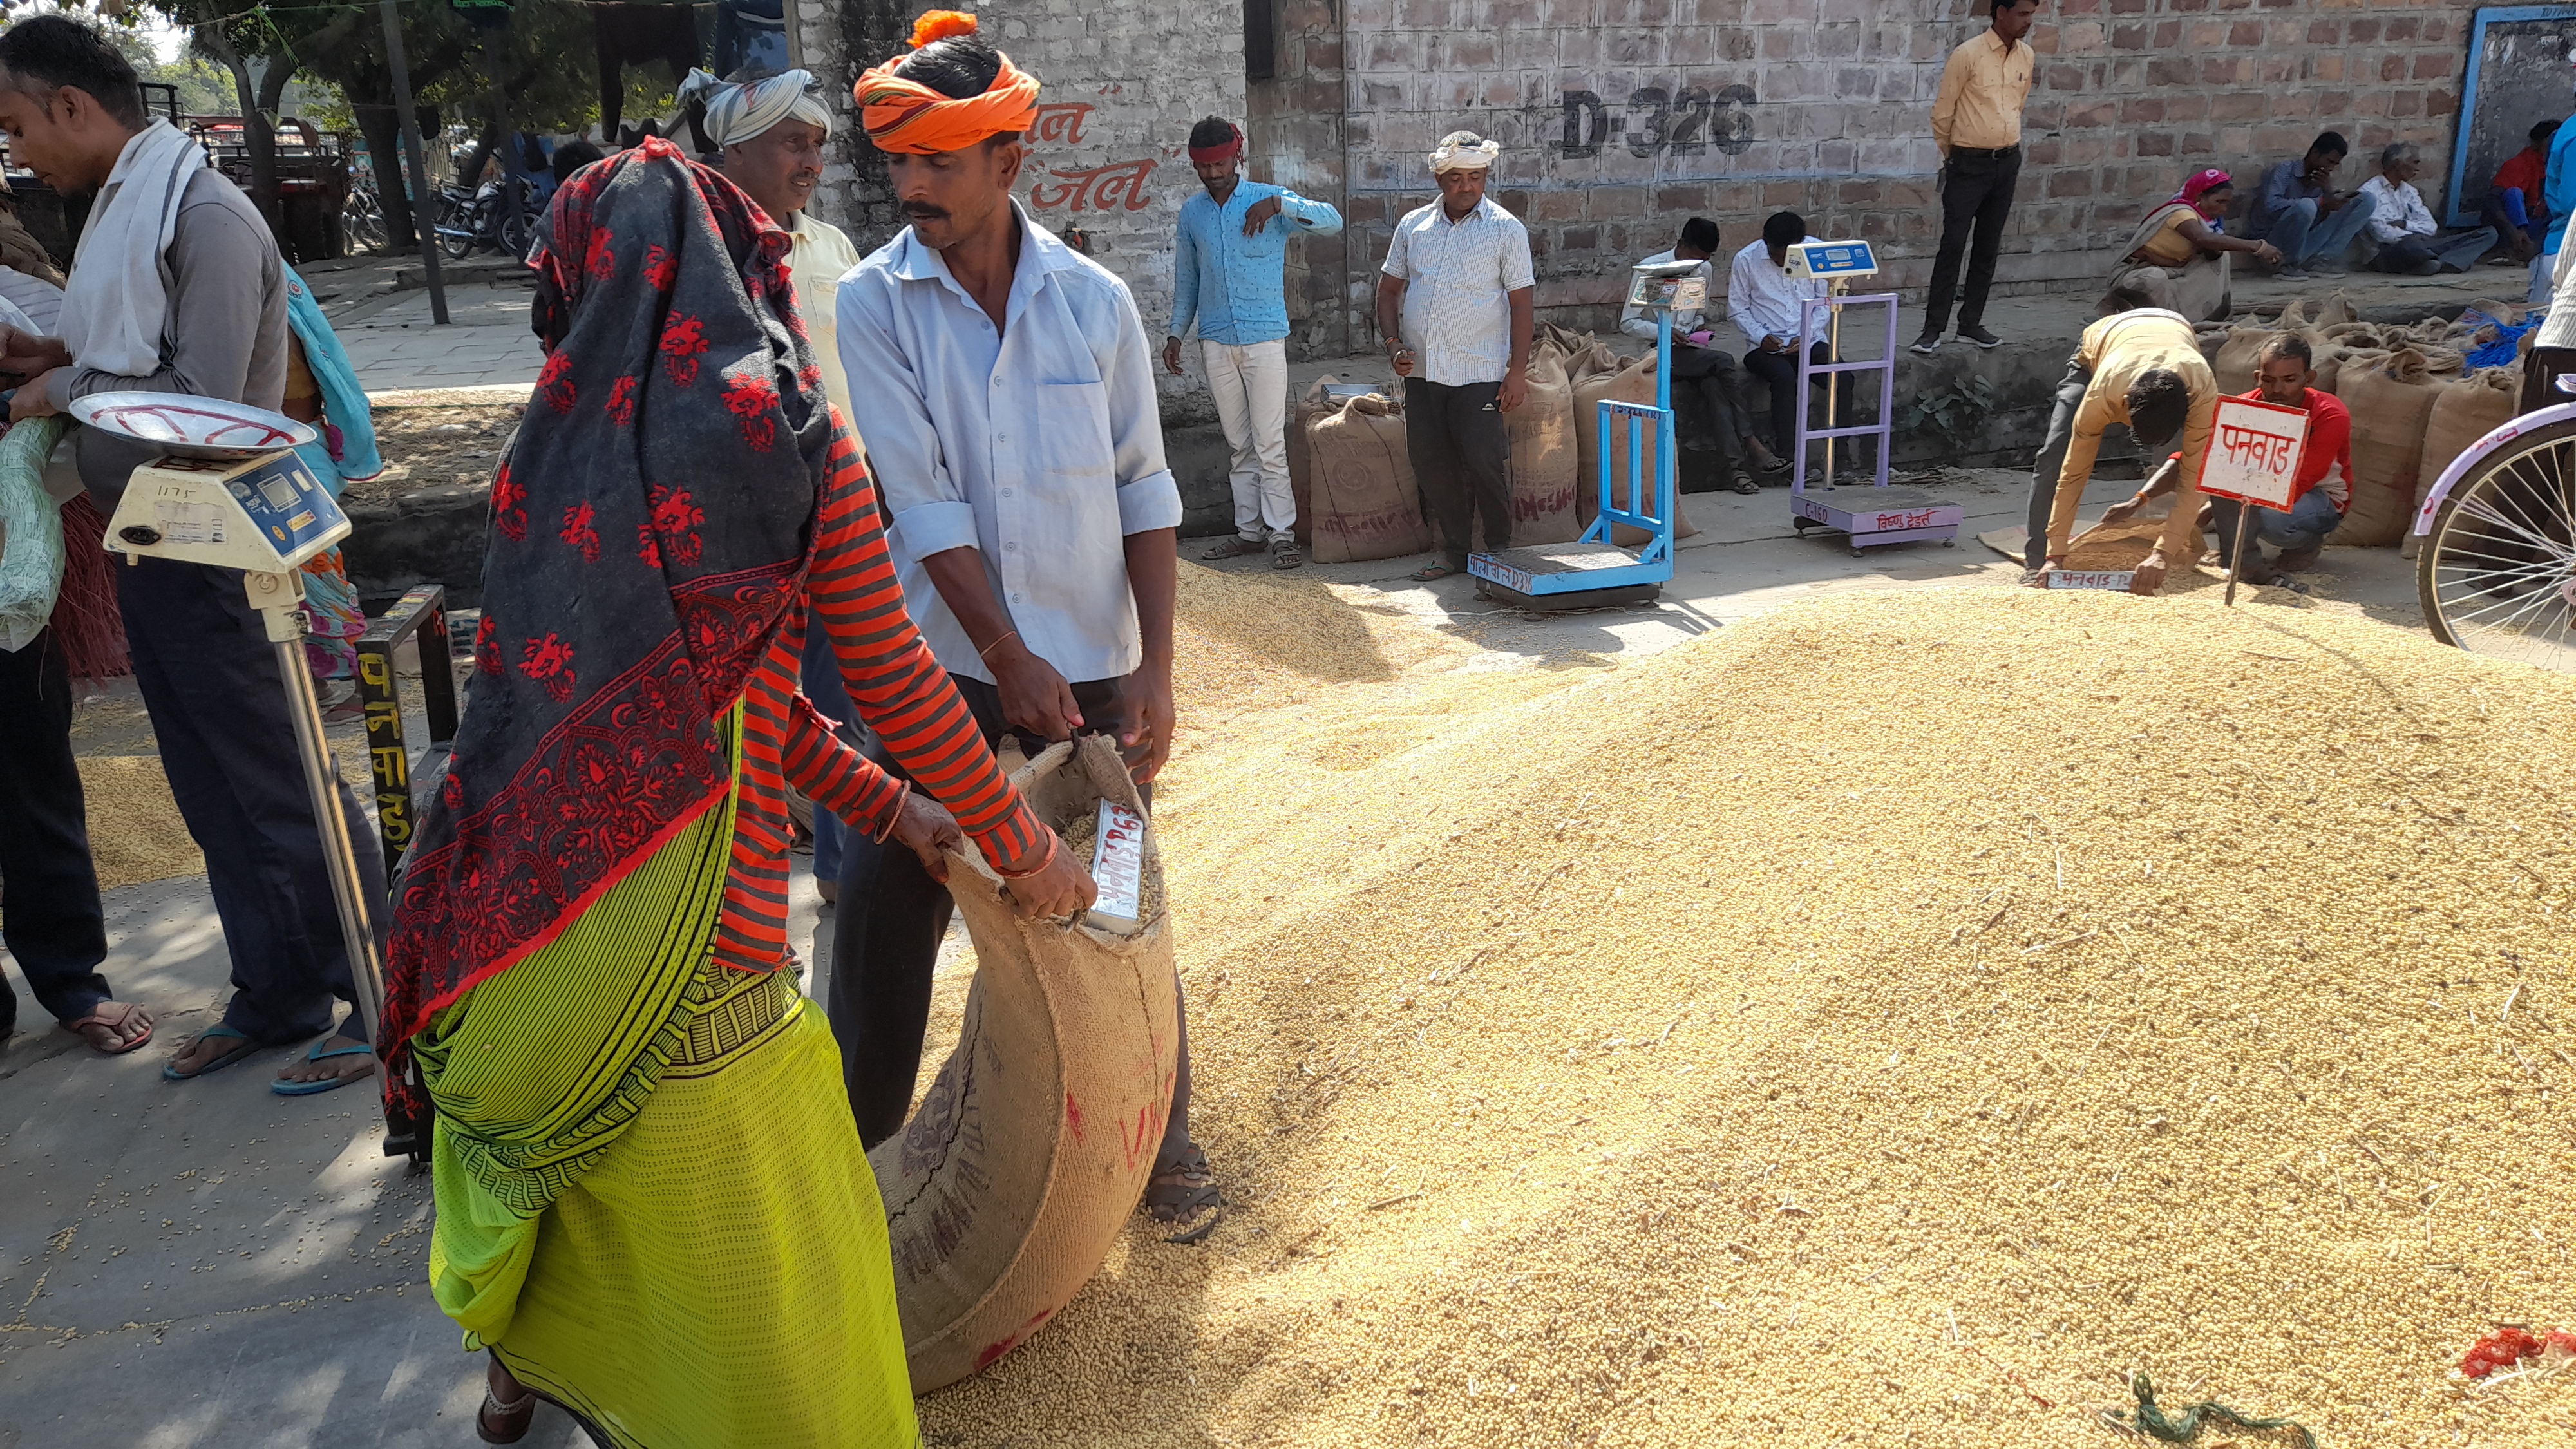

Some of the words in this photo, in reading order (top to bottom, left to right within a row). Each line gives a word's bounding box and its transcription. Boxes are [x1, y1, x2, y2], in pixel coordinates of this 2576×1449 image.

[1563, 84, 1757, 160] D-326
[158, 485, 196, 498] 1175
[1876, 513, 1904, 530] विष्णु
